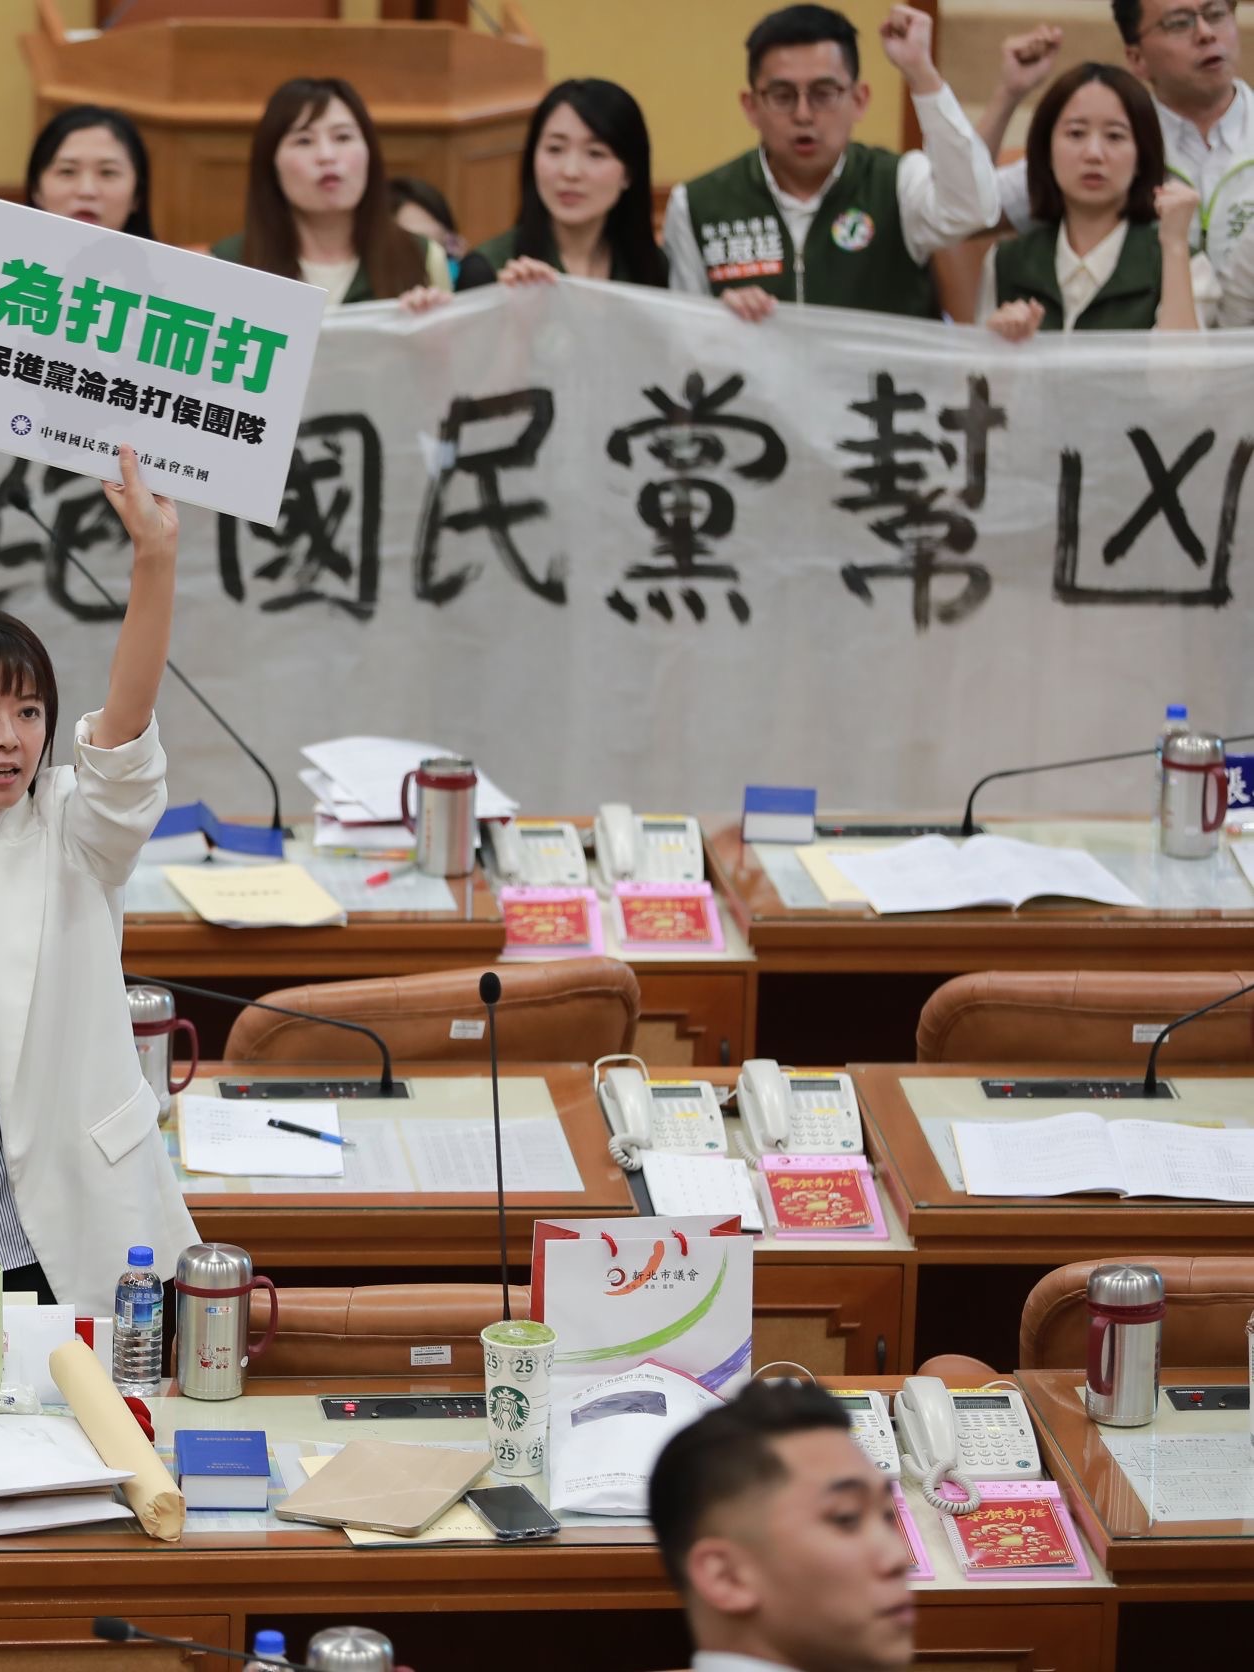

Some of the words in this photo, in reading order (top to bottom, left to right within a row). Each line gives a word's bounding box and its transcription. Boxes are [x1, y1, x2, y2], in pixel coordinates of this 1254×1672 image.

[39, 425, 210, 482] 中國國民黨新市議會黨團
[632, 1268, 699, 1282] 新北市議會
[487, 1352, 498, 1369] 25
[515, 1359, 534, 1373] 25
[499, 1446, 515, 1461] 25
